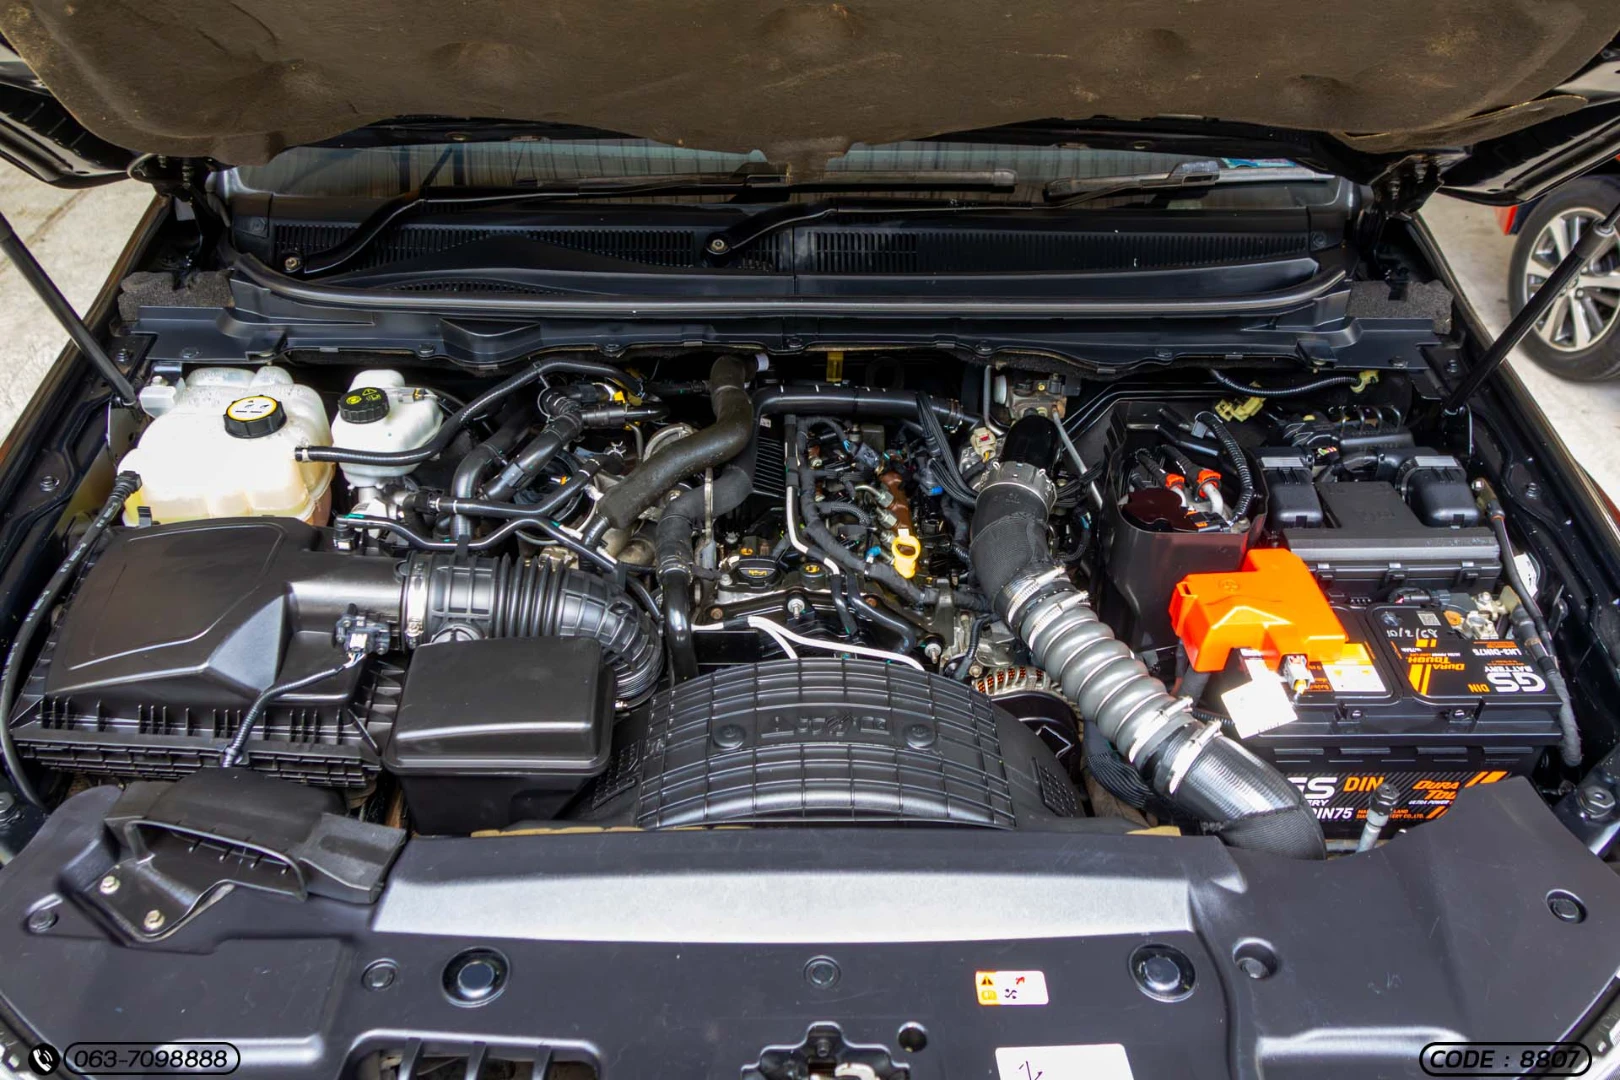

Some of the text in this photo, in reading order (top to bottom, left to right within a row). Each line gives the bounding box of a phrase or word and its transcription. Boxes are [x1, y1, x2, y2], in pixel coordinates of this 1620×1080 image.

[1407, 656, 1451, 664] TOUGH
[1432, 663, 1465, 671] DURA
[1484, 665, 1533, 673] BATTERY
[1486, 672, 1546, 693] GS
[1467, 683, 1490, 693] DIN
[1342, 776, 1385, 792] DIN
